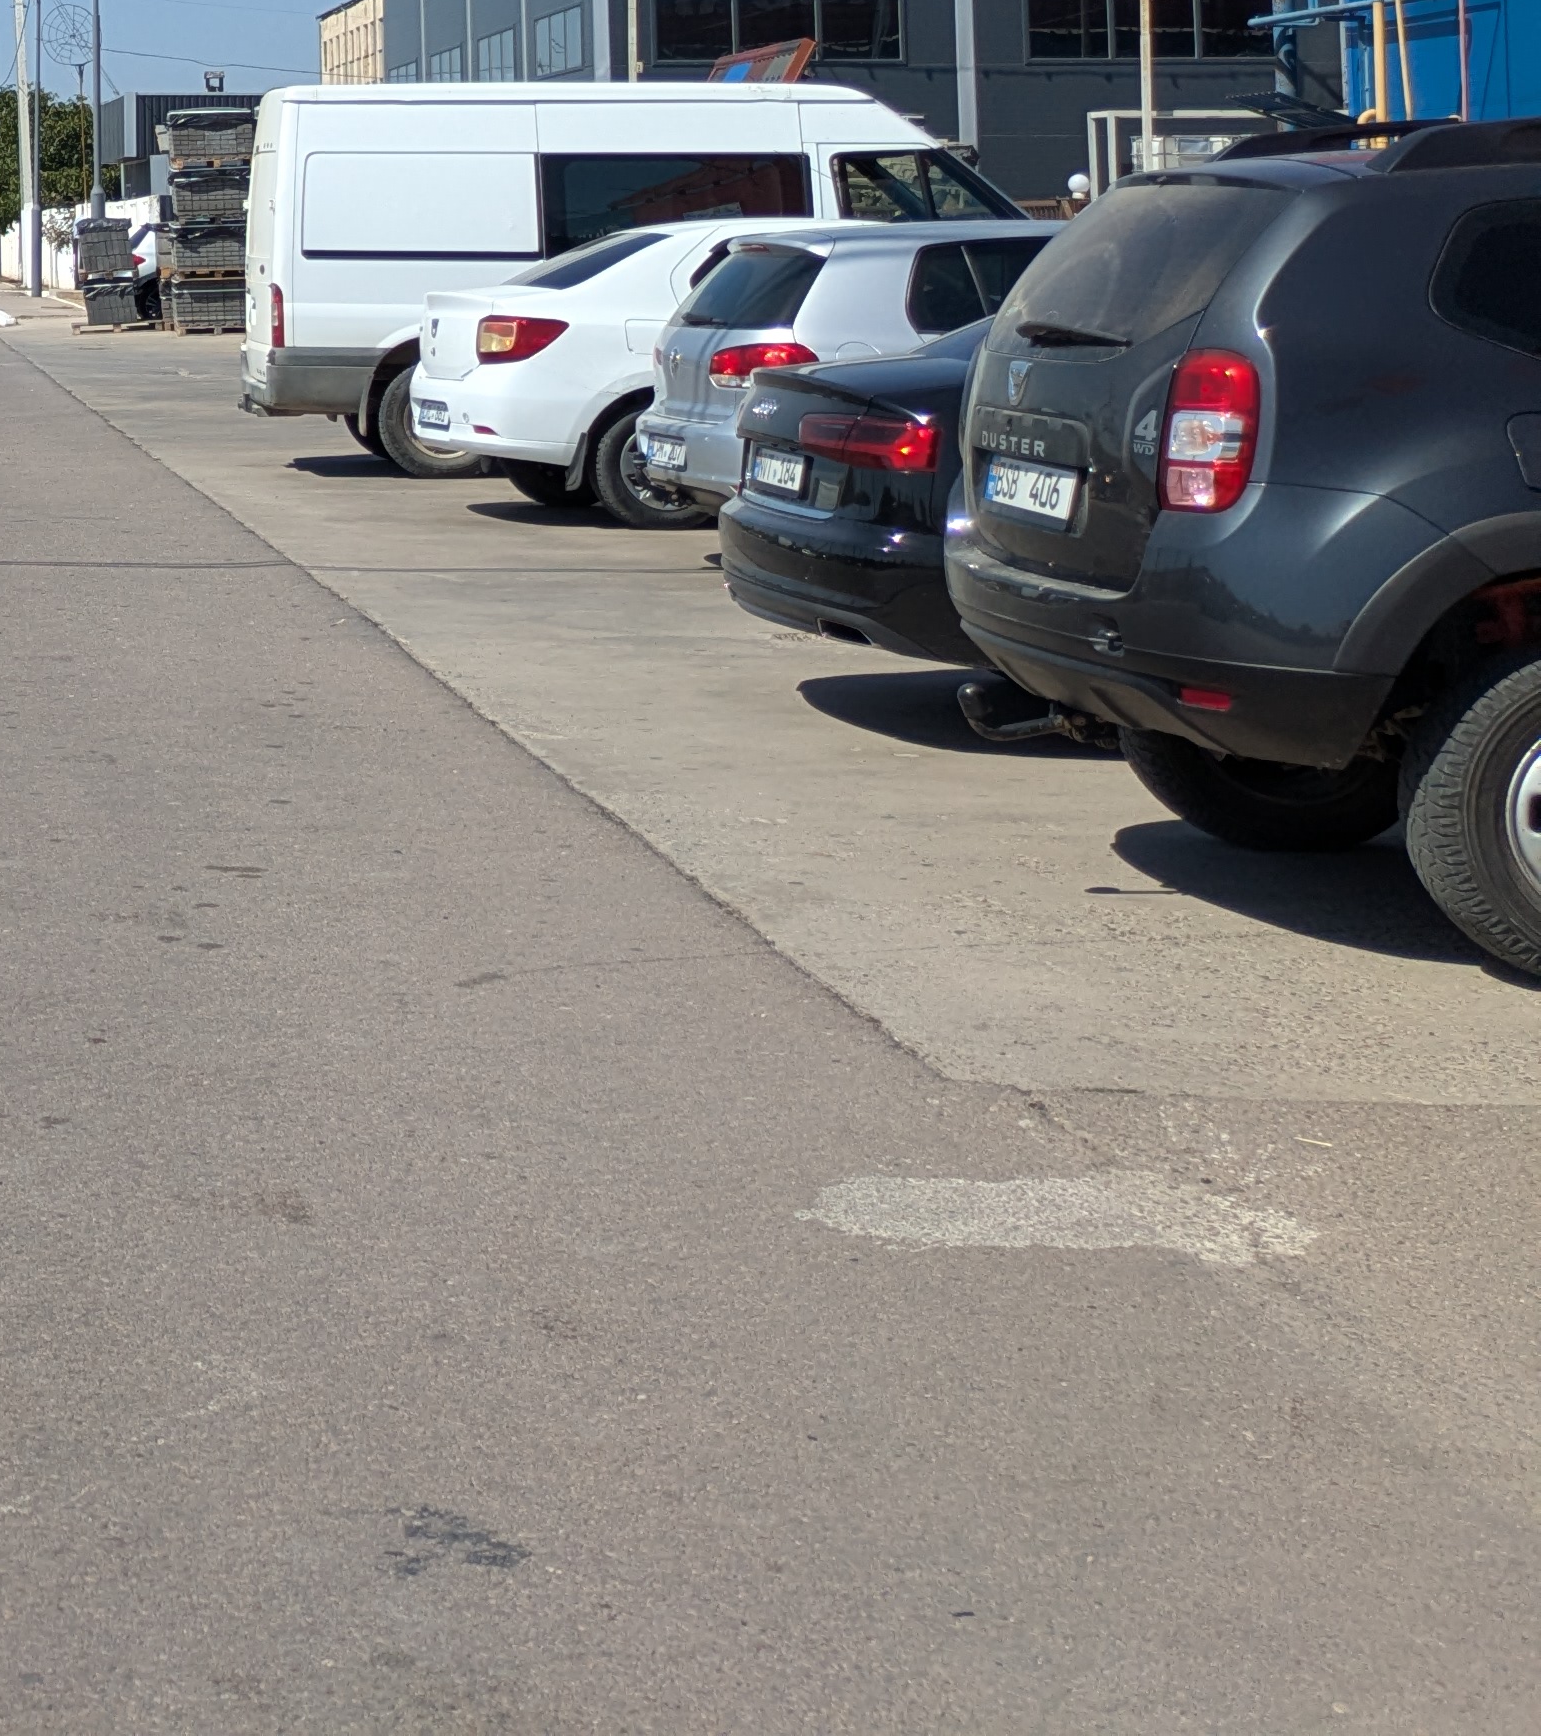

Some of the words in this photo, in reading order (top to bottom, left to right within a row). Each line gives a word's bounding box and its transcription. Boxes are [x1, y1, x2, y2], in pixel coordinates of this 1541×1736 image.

[1134, 409, 1157, 441] 4
[981, 430, 1046, 458] DUSTER
[1133, 443, 1155, 456] WD
[777, 456, 798, 487] 184
[995, 462, 1020, 501] BSB
[1028, 471, 1061, 511] 406
